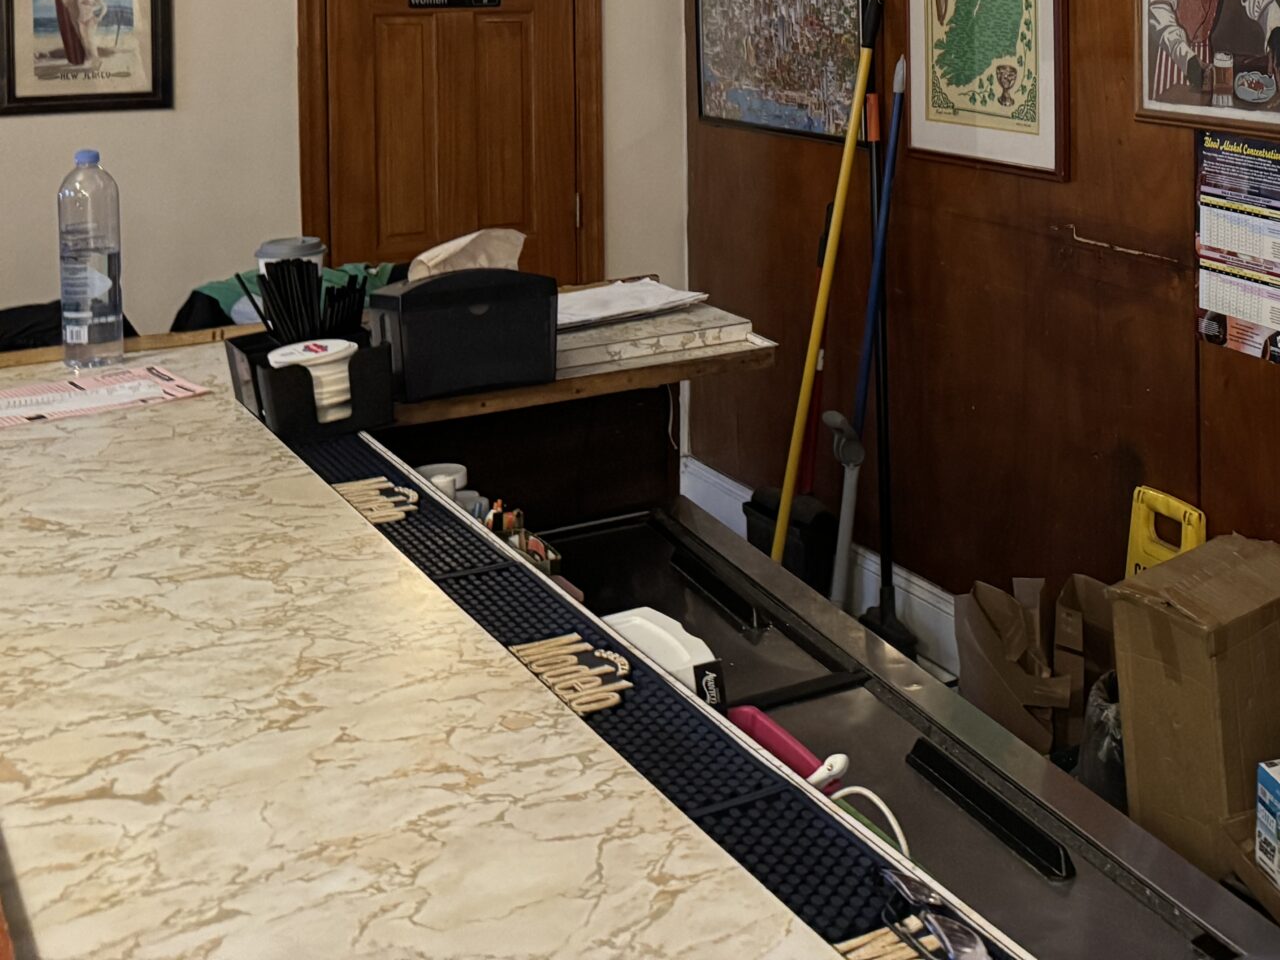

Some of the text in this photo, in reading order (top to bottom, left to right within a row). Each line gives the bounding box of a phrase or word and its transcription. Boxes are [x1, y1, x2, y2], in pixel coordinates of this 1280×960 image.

[1204, 137, 1220, 149] Blood
[1220, 140, 1242, 154] Alcohol
[508, 631, 635, 716] Modelo
